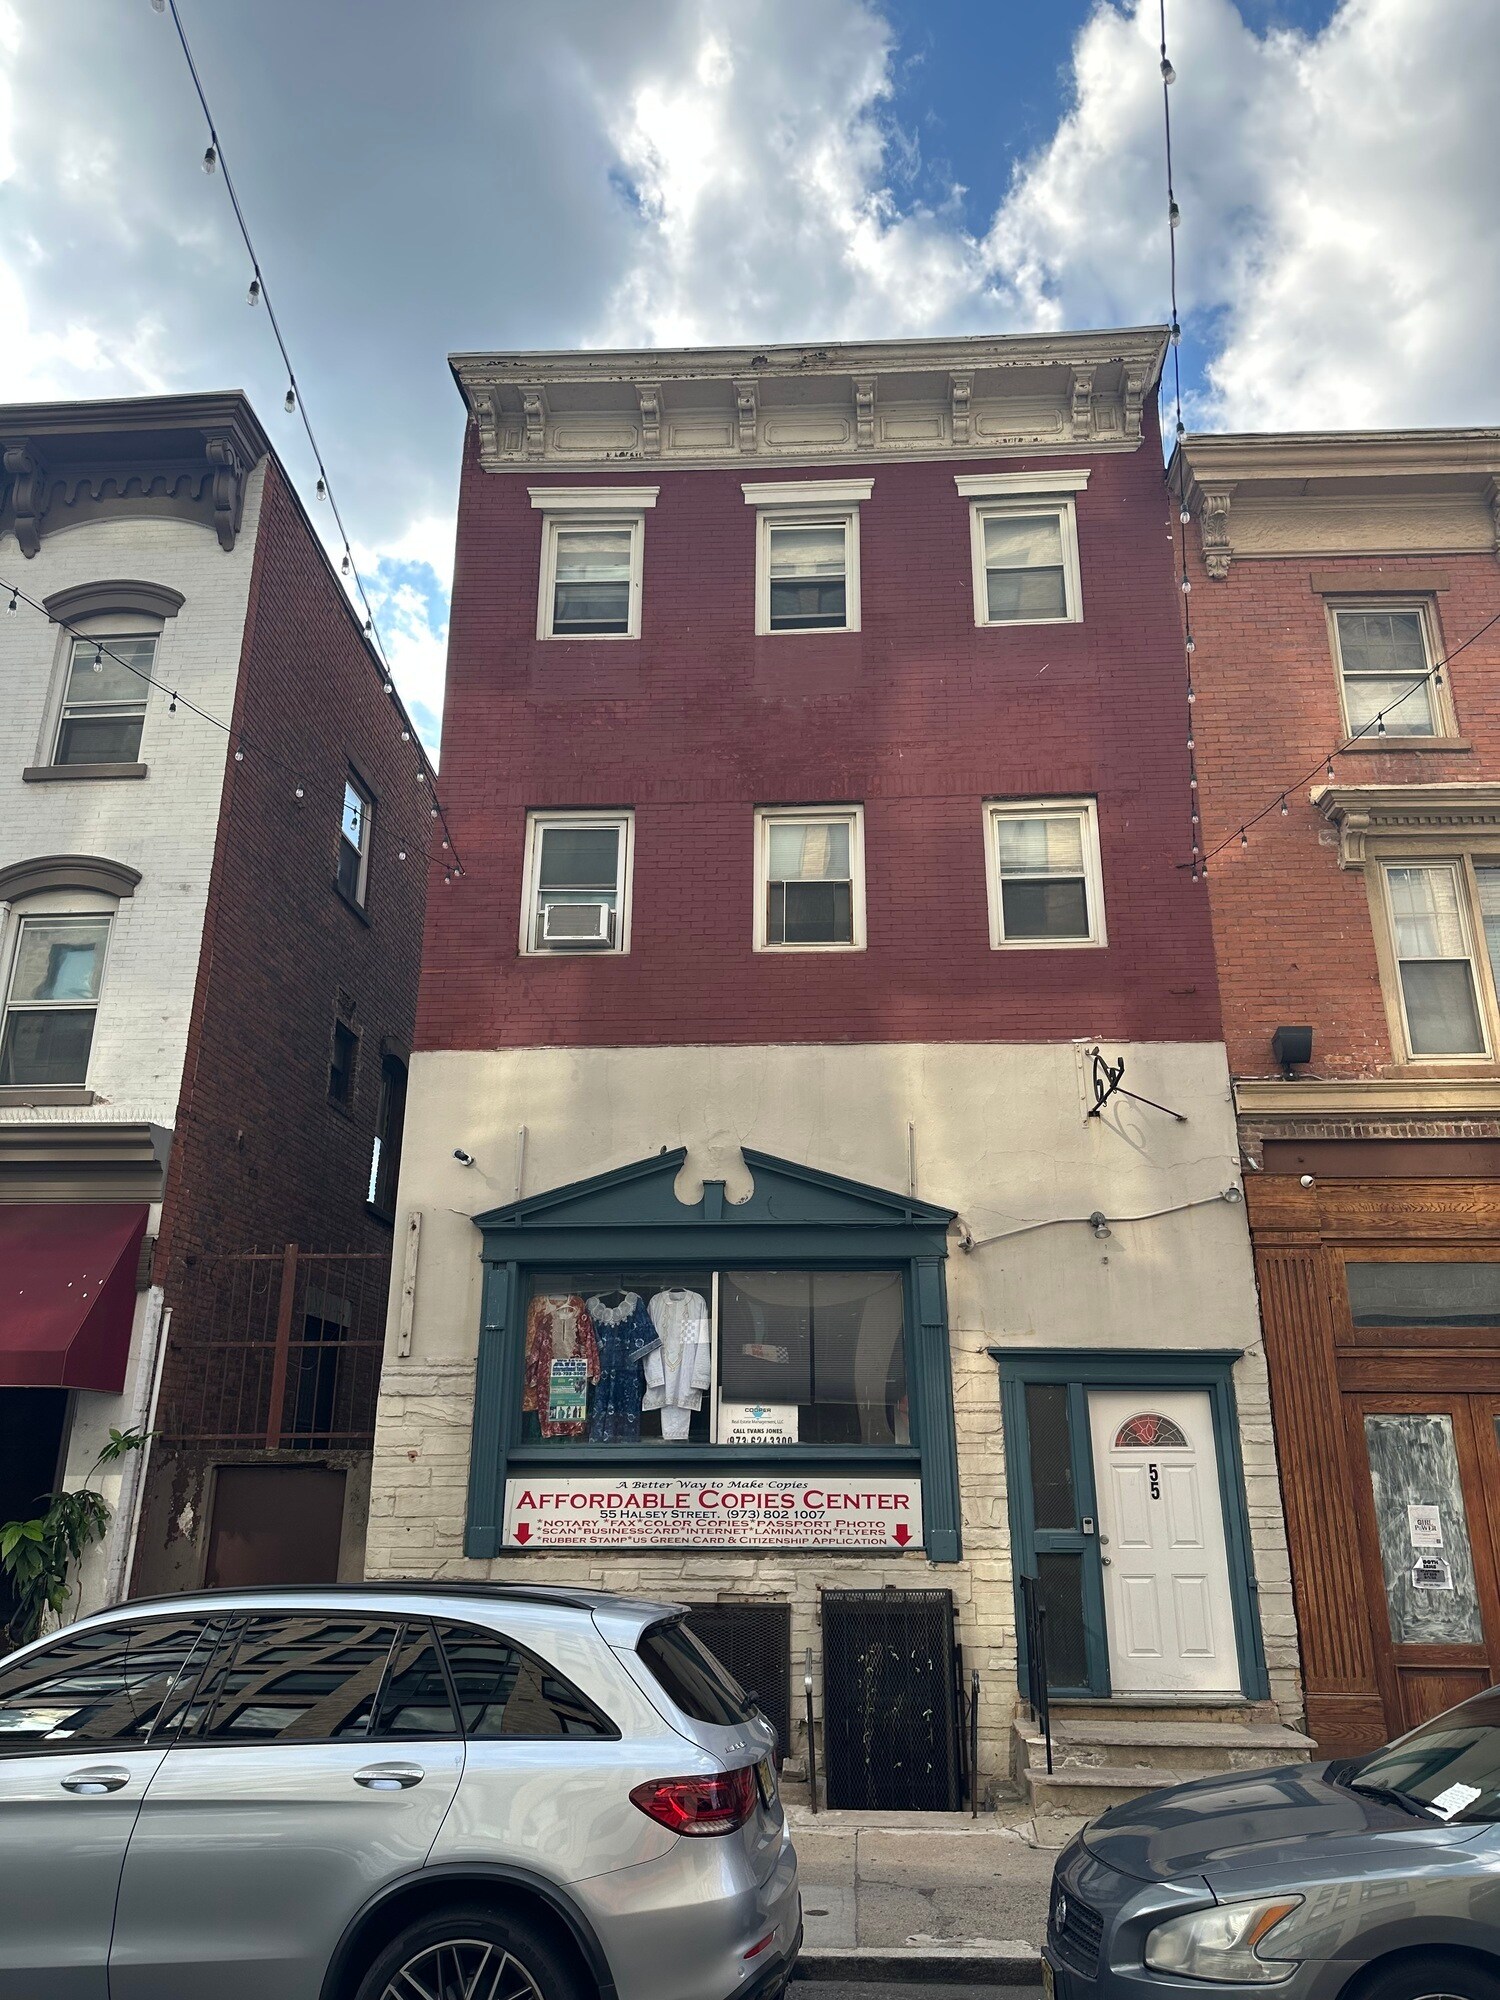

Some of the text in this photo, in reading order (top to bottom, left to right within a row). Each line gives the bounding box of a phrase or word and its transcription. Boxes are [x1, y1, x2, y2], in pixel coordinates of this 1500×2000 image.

[616, 1480, 809, 1491] A Better Way to Make Copies
[516, 1489, 911, 1510] AFFORDABLE COPIES CENTER
[600, 1510, 617, 1519] 55
[620, 1510, 668, 1519] HALSEY
[727, 1510, 760, 1520] (973)
[763, 1510, 790, 1519] 802
[793, 1510, 826, 1520] 1007
[835, 1519, 886, 1528] PHOTO
[649, 1536, 689, 1544] GREEN
[692, 1536, 725, 1544] CARD
[739, 1536, 809, 1545] CITIZENSHIP
[812, 1537, 887, 1545] APPLICATION
